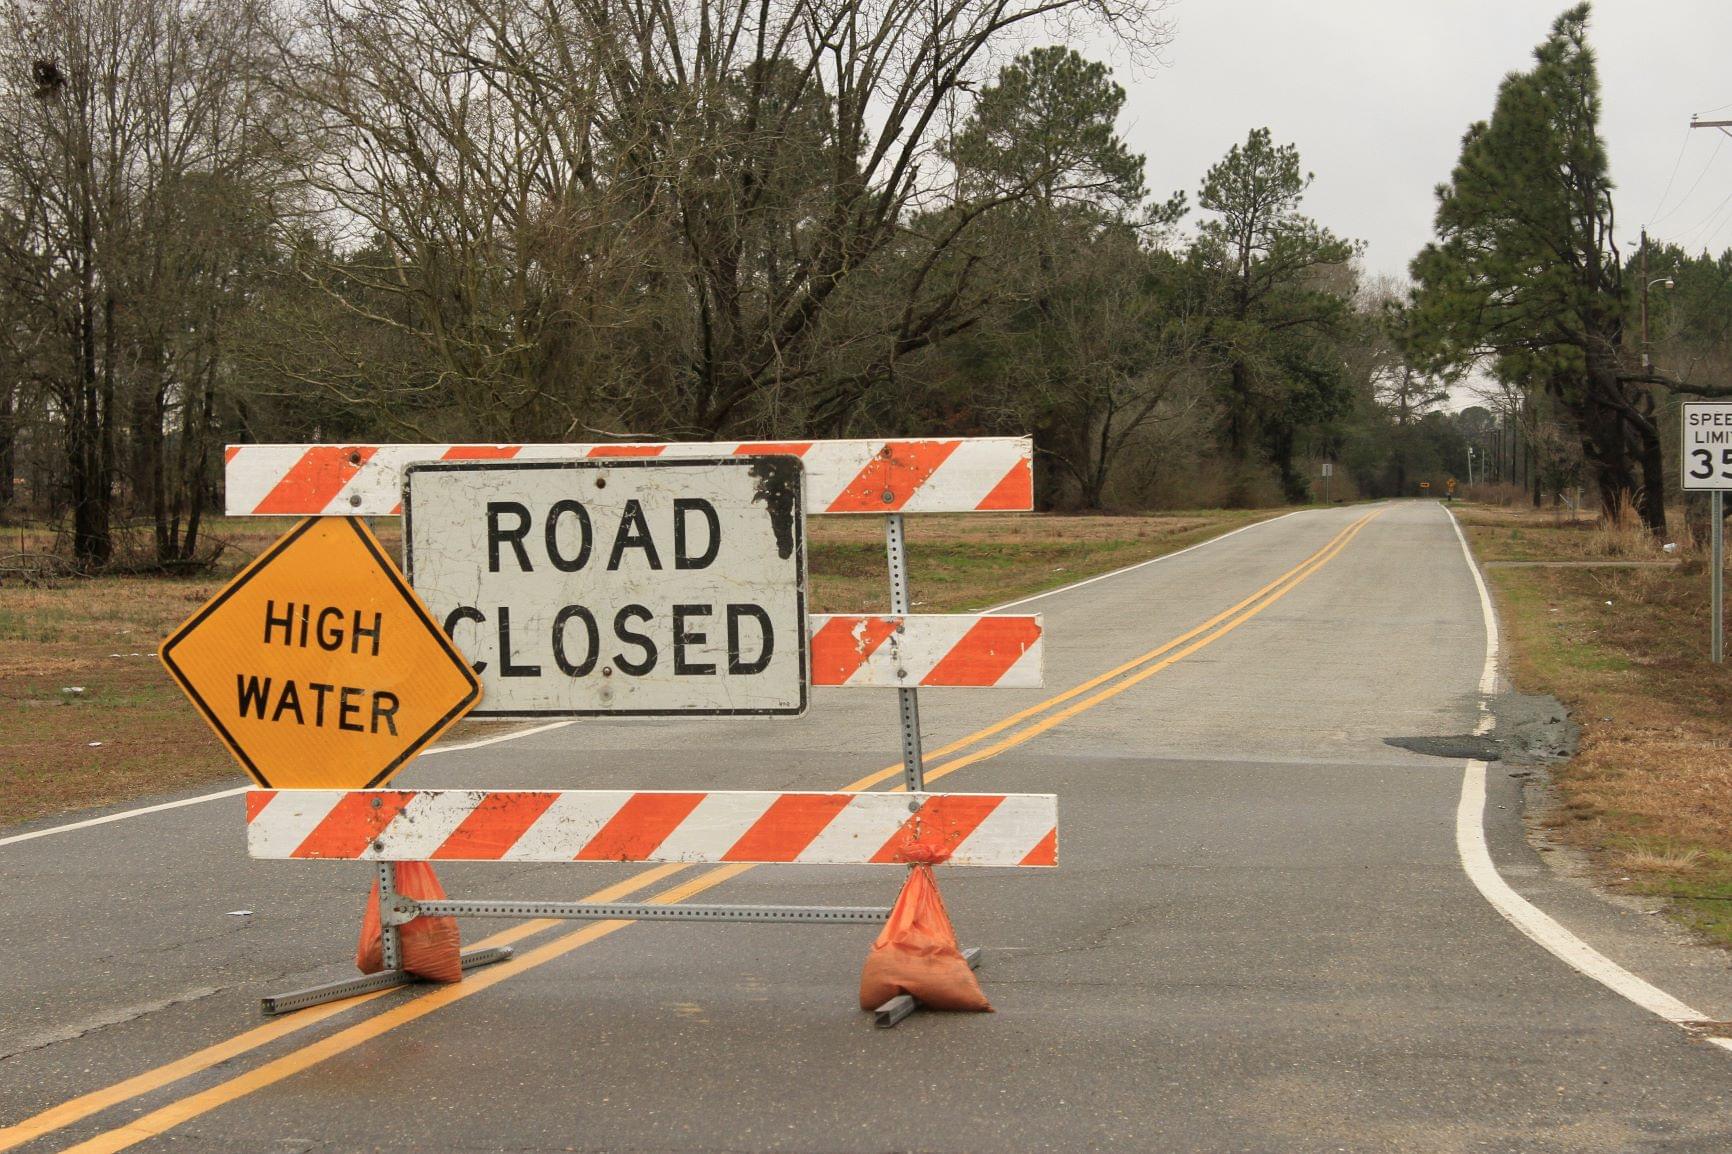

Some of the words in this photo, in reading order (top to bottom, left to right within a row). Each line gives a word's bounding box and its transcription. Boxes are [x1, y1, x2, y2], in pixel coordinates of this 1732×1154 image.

[1690, 413, 1732, 426] SPEE
[1695, 431, 1732, 444] LIMI
[487, 498, 721, 573] ROAD
[263, 600, 382, 657] HIGH
[444, 603, 774, 678] CLOSED
[236, 674, 400, 737] WATER
